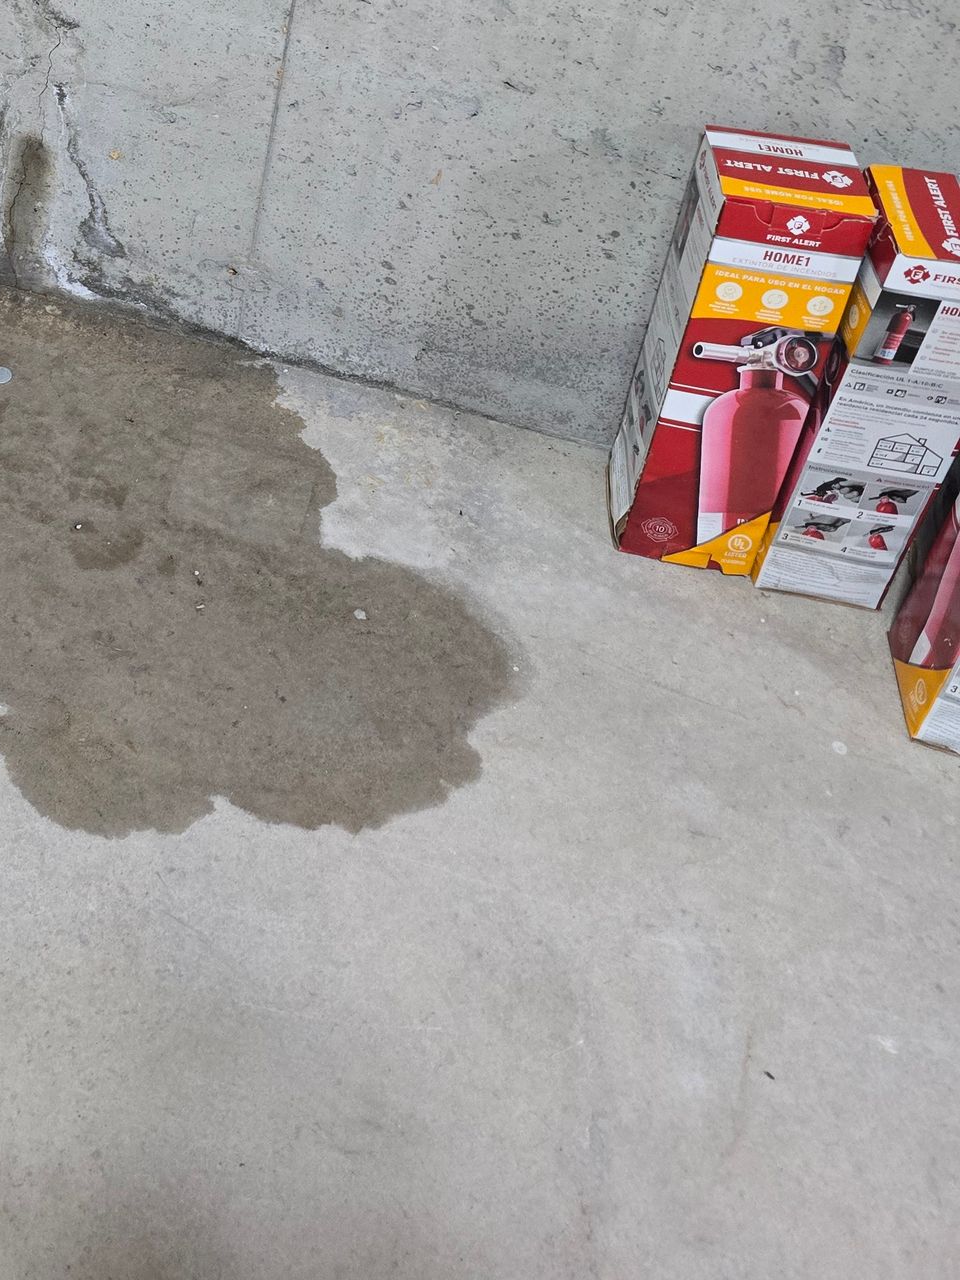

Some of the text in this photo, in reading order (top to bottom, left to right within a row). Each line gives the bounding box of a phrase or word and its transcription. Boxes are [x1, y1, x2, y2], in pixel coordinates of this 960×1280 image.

[757, 143, 804, 157] HOME1
[723, 158, 821, 181] FIRST ALERT
[923, 175, 959, 237] FIRST ALERT
[766, 233, 821, 248] FIRST ALERT
[763, 250, 812, 267] HOME1
[732, 257, 838, 279] EXTINTOR DE INCENDIOS
[715, 270, 846, 296] IDEAL PARA USO EN EL HOGAR
[940, 305, 960, 317] HO
[856, 510, 864, 520] 2
[781, 532, 789, 541] 3
[840, 545, 848, 554] 4
[950, 684, 958, 694] 3
